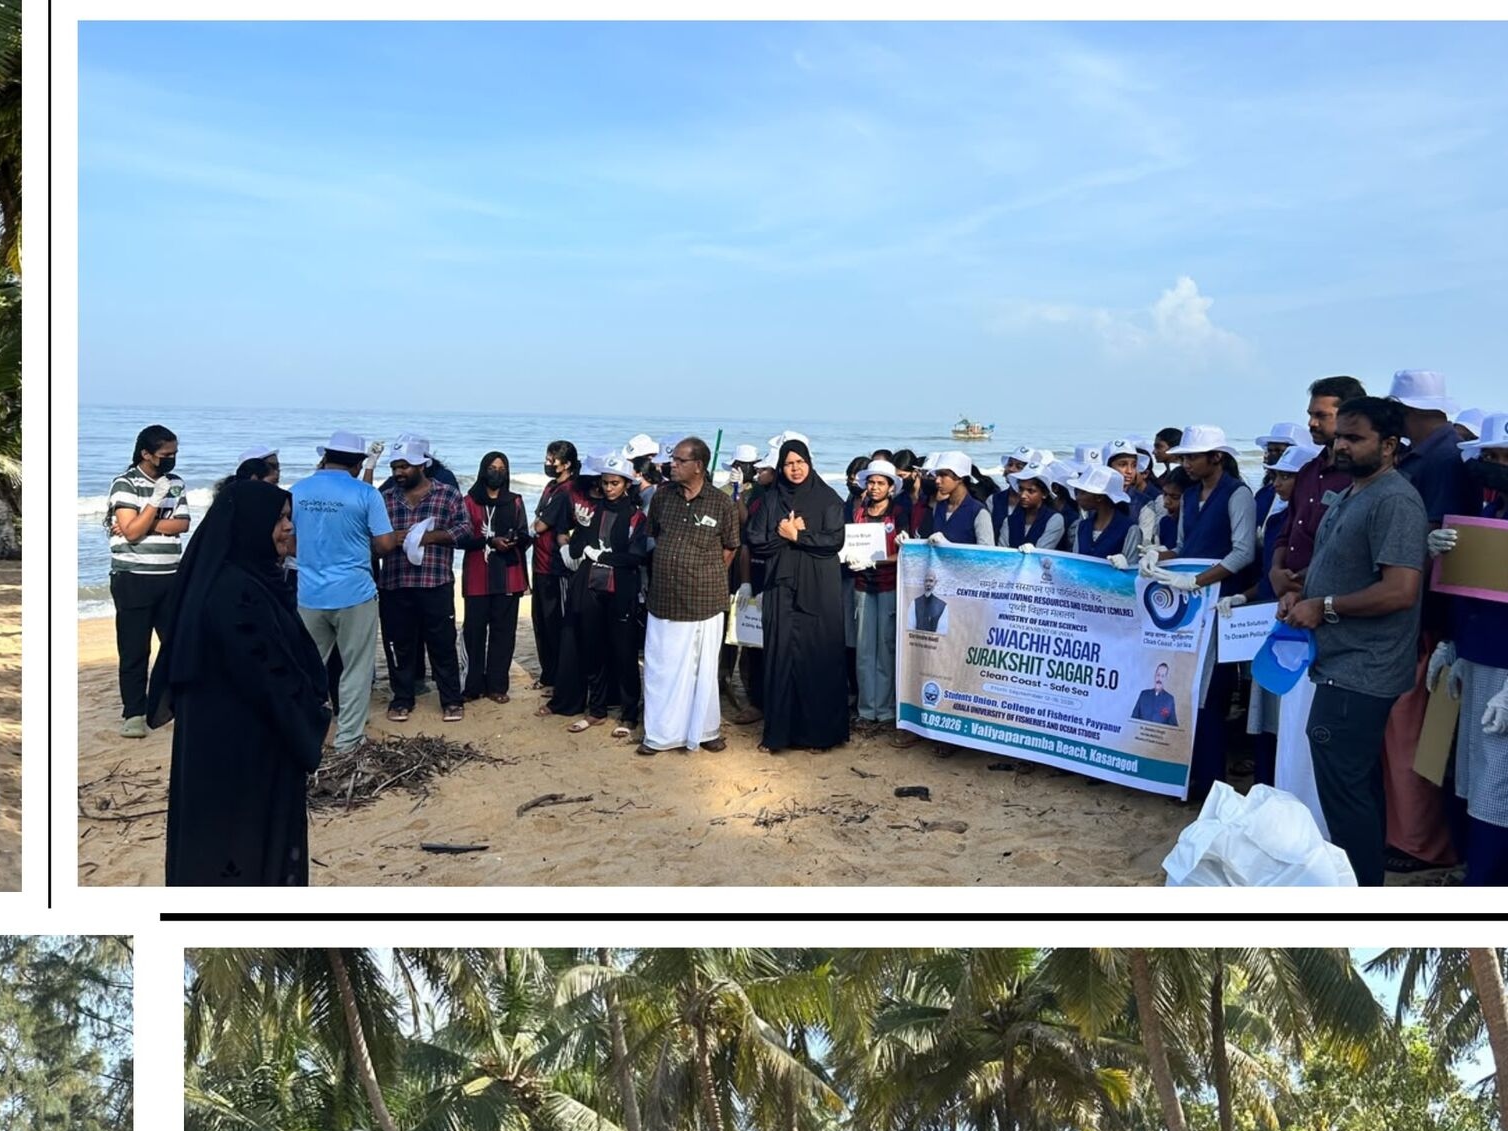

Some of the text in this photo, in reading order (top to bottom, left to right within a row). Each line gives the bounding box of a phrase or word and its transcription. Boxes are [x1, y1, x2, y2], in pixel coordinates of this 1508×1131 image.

[957, 588, 978, 598] CENTRE
[979, 589, 991, 599] FOR
[1010, 592, 1032, 603] LIVING
[1034, 596, 1070, 608] RESOURCES
[1081, 602, 1106, 614] ECOLOGY
[998, 614, 1087, 632] MINISTRY OF EARTH SCIENCES
[986, 627, 1101, 663] SWACHH SAGAR
[965, 646, 1119, 690] SURAKSHIT SAGAR 5.0
[980, 670, 1089, 697] Clean Coast Safe Sea
[944, 690, 972, 702] Students
[1001, 701, 1036, 715] College
[1037, 707, 1046, 716] of
[1086, 718, 1121, 733] Payyanur
[970, 706, 1005, 719] UNIVERSITY
[1006, 712, 1014, 720] OF
[1015, 714, 1046, 728] FISHERIES
[1046, 721, 1058, 731] AND
[1059, 724, 1077, 734] OCEAN
[1078, 727, 1100, 740] STUDIES
[971, 722, 1055, 751] Valiyaparamba
[1090, 748, 1138, 773] Kasaragod
